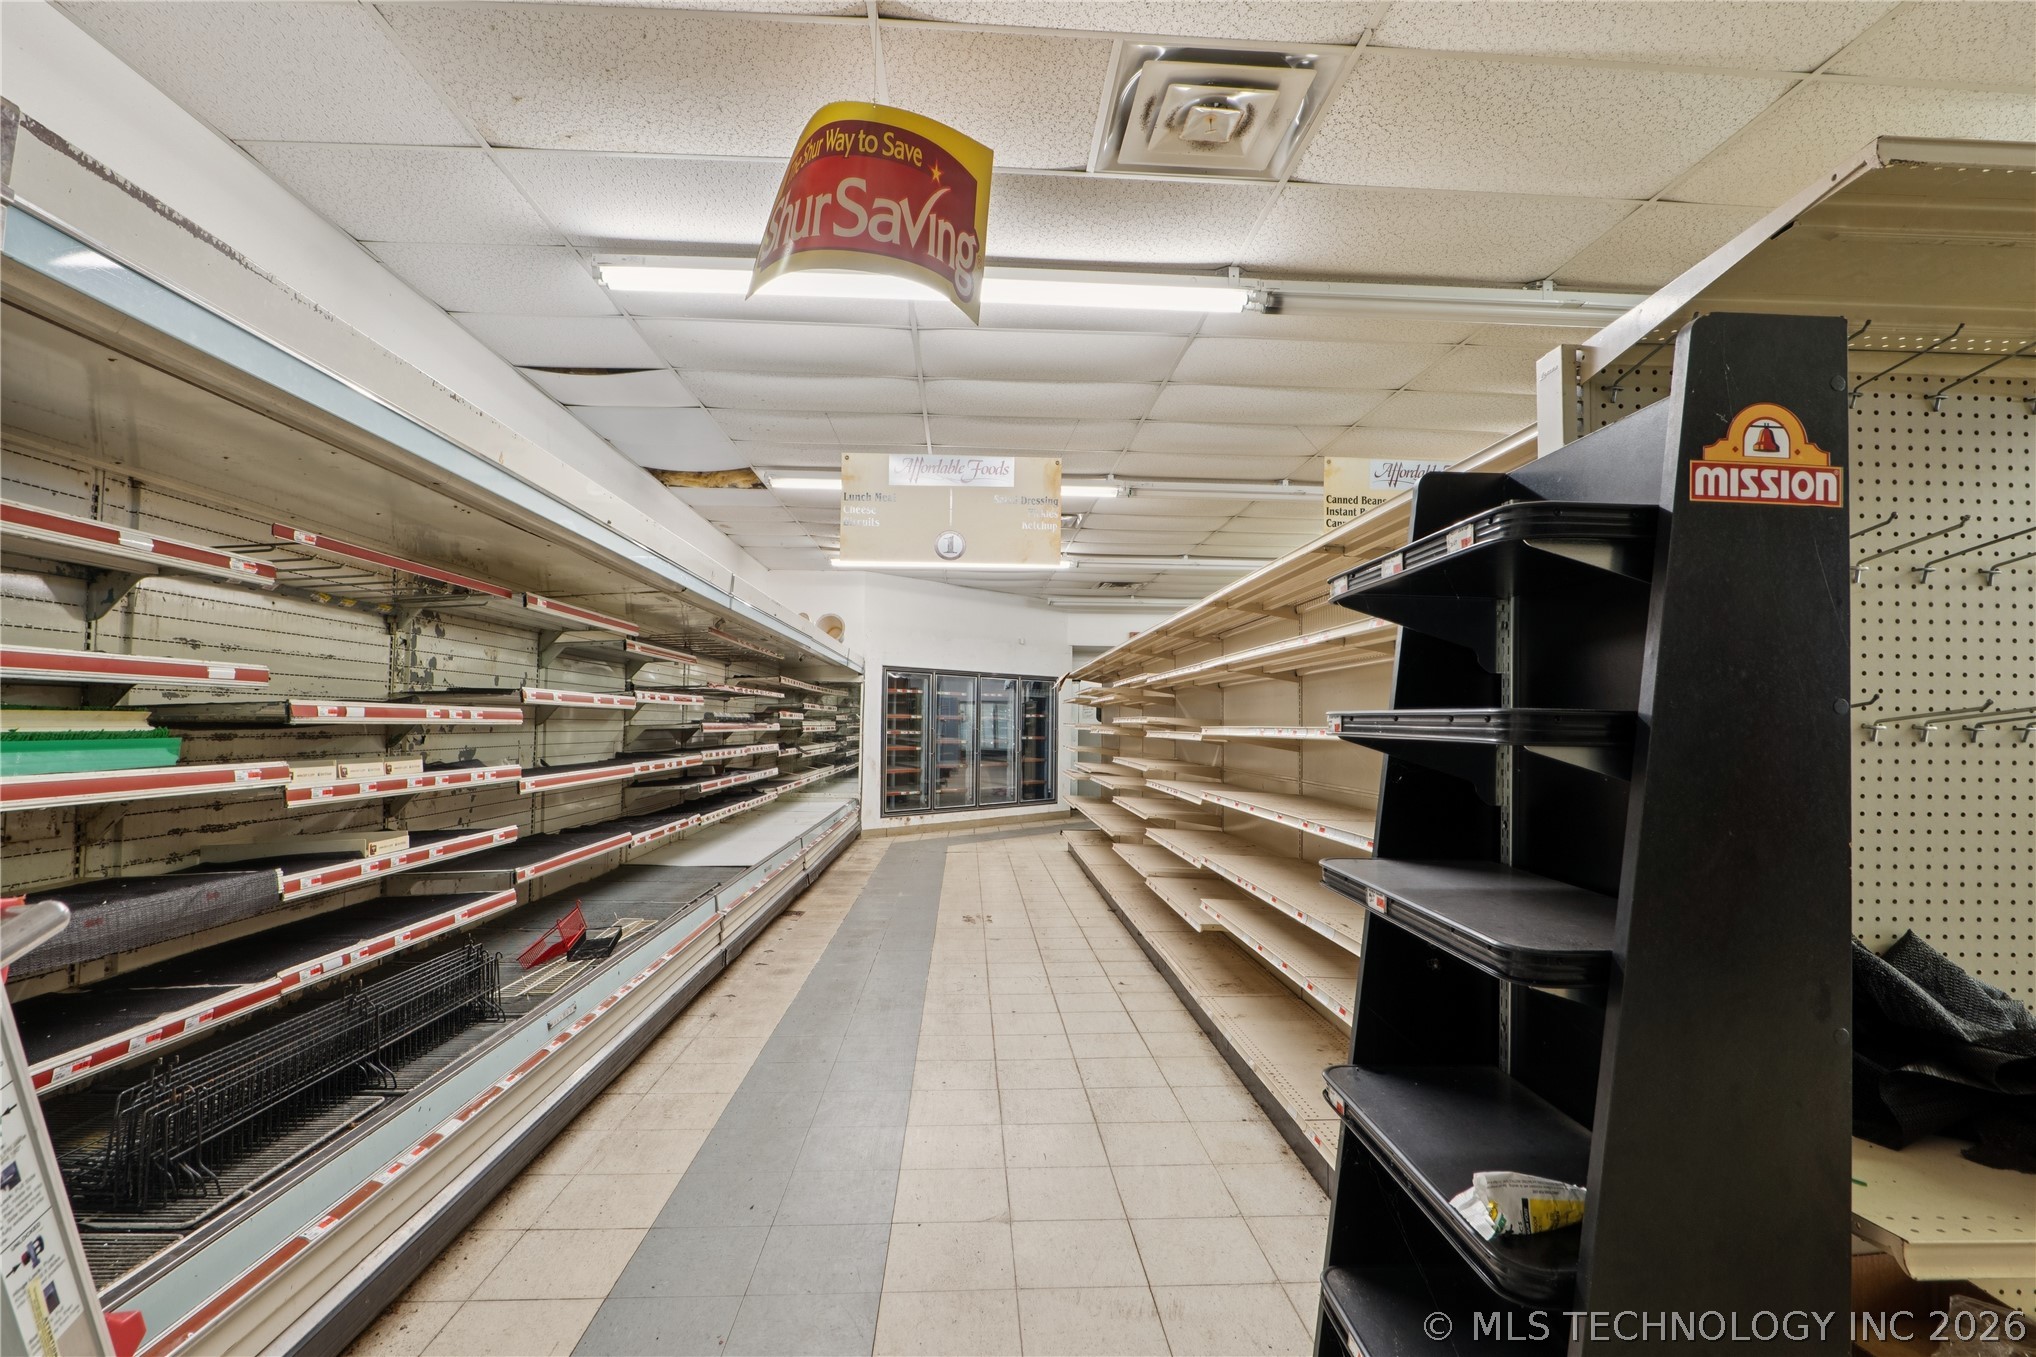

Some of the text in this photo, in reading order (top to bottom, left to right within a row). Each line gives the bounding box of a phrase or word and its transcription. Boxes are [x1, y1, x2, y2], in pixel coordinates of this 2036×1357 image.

[826, 127, 855, 158] Way
[858, 129, 878, 153] to
[882, 132, 923, 167] Save
[894, 456, 1010, 483] Affordable Foods
[843, 492, 871, 502] Lunch
[1021, 496, 1059, 507] Dressing
[1326, 495, 1358, 505] Canned
[843, 505, 877, 515] Cheese
[1326, 507, 1357, 516] Instant
[1022, 521, 1058, 533] Ketchup
[943, 535, 958, 554] 1
